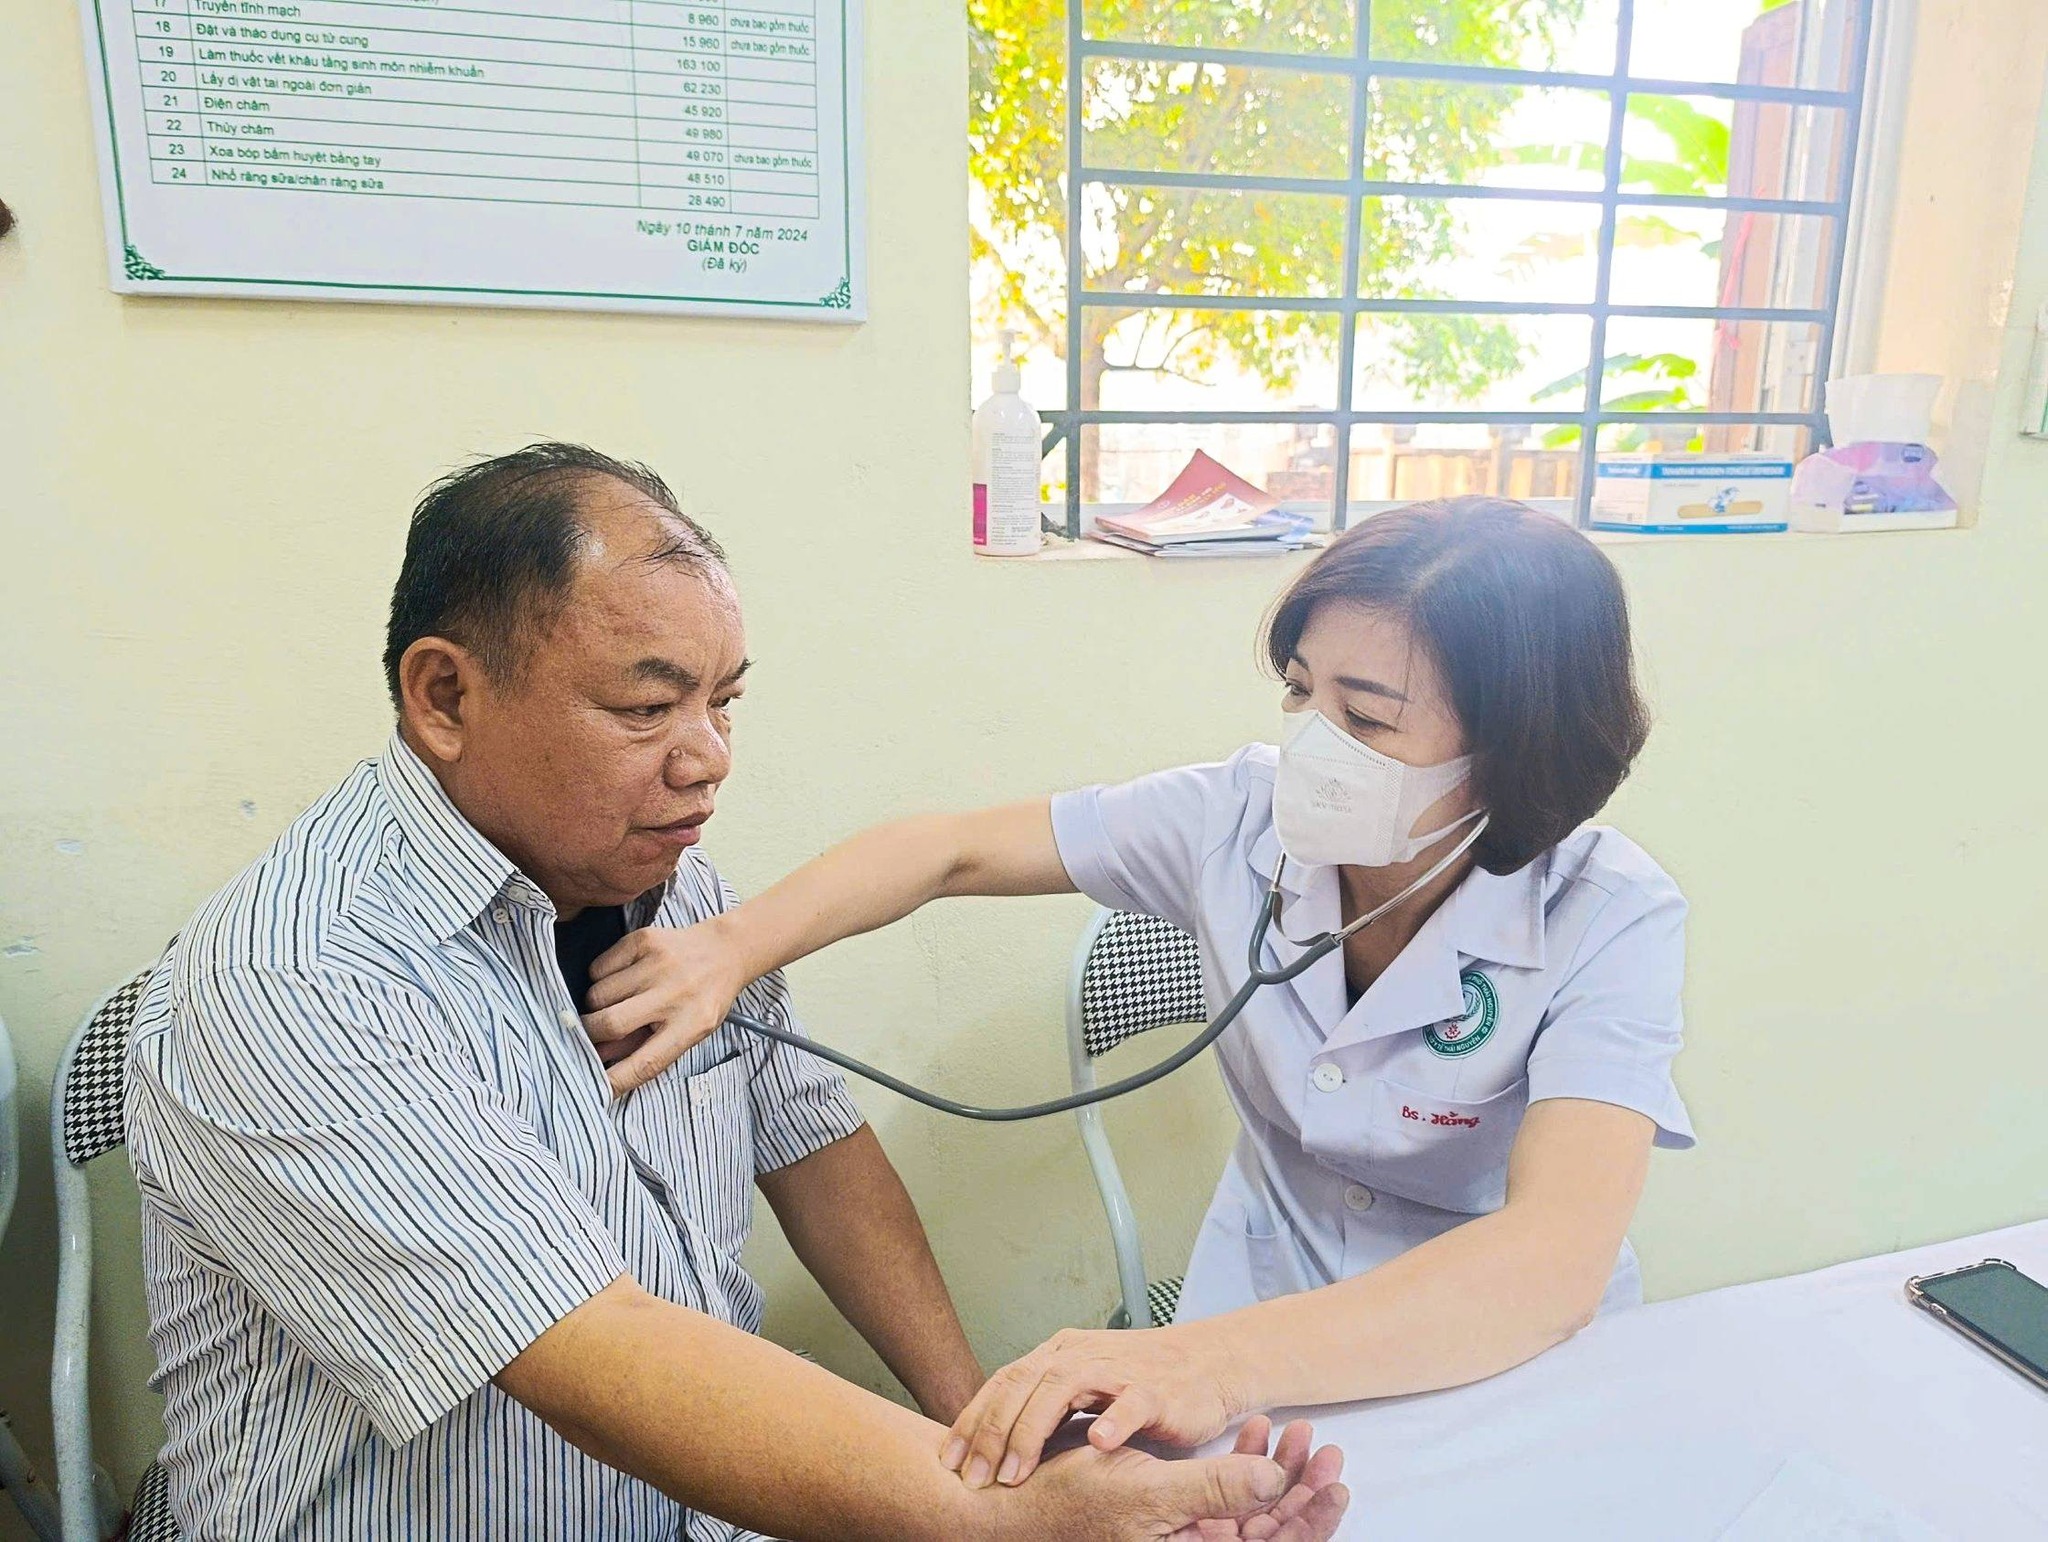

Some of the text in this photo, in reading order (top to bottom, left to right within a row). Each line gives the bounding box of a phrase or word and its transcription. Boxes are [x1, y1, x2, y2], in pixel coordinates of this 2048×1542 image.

[241, 3, 264, 14] tĩnh
[268, 5, 301, 17] mạch
[688, 13, 695, 24] 8
[156, 21, 171, 32] 18
[730, 17, 750, 29] chưa
[753, 19, 768, 30] bao
[788, 21, 810, 34] thuốc
[196, 23, 218, 36] Đặt
[222, 25, 237, 37] và
[339, 36, 369, 49] cung
[683, 36, 720, 49] 15 960
[159, 46, 173, 57] 19
[731, 40, 750, 51] chưa
[753, 41, 768, 52] bao
[788, 44, 810, 56] thuốc
[200, 48, 226, 60] Làm
[230, 50, 263, 63] thuốc
[268, 52, 286, 64] vết
[289, 53, 318, 67] khâu
[352, 59, 377, 71] sinh
[380, 61, 406, 72] môn
[677, 59, 721, 72] 163 100
[161, 71, 176, 82] 20
[227, 75, 239, 87] dị
[242, 76, 261, 88] vật
[264, 78, 279, 89] tai
[282, 79, 315, 92] ngoài
[319, 80, 343, 92] đơn
[683, 82, 721, 95] 62 230
[164, 95, 178, 106] 21
[204, 97, 270, 111] Điện châm
[684, 105, 722, 118] 45 920
[166, 120, 181, 131] 22
[241, 123, 274, 135] châm
[685, 128, 699, 139] 49
[169, 144, 185, 155] 23
[209, 145, 234, 157] Xoa
[237, 147, 260, 160] bóp
[363, 155, 381, 168] tay
[686, 150, 724, 163] 49 070
[734, 154, 755, 164] chưa
[756, 155, 770, 165] bao
[791, 156, 812, 168] thuốc
[172, 168, 187, 179] 24
[704, 174, 724, 185] 510
[361, 178, 384, 190] sữa
[705, 196, 726, 207] 490
[637, 220, 671, 236] Ngày
[677, 223, 691, 235] 10
[735, 226, 742, 237] 7
[746, 226, 774, 240] năm
[777, 228, 808, 241] 2024
[687, 238, 724, 253] GIÁM
[1456, 1035, 1481, 1051] NGUYÊN
